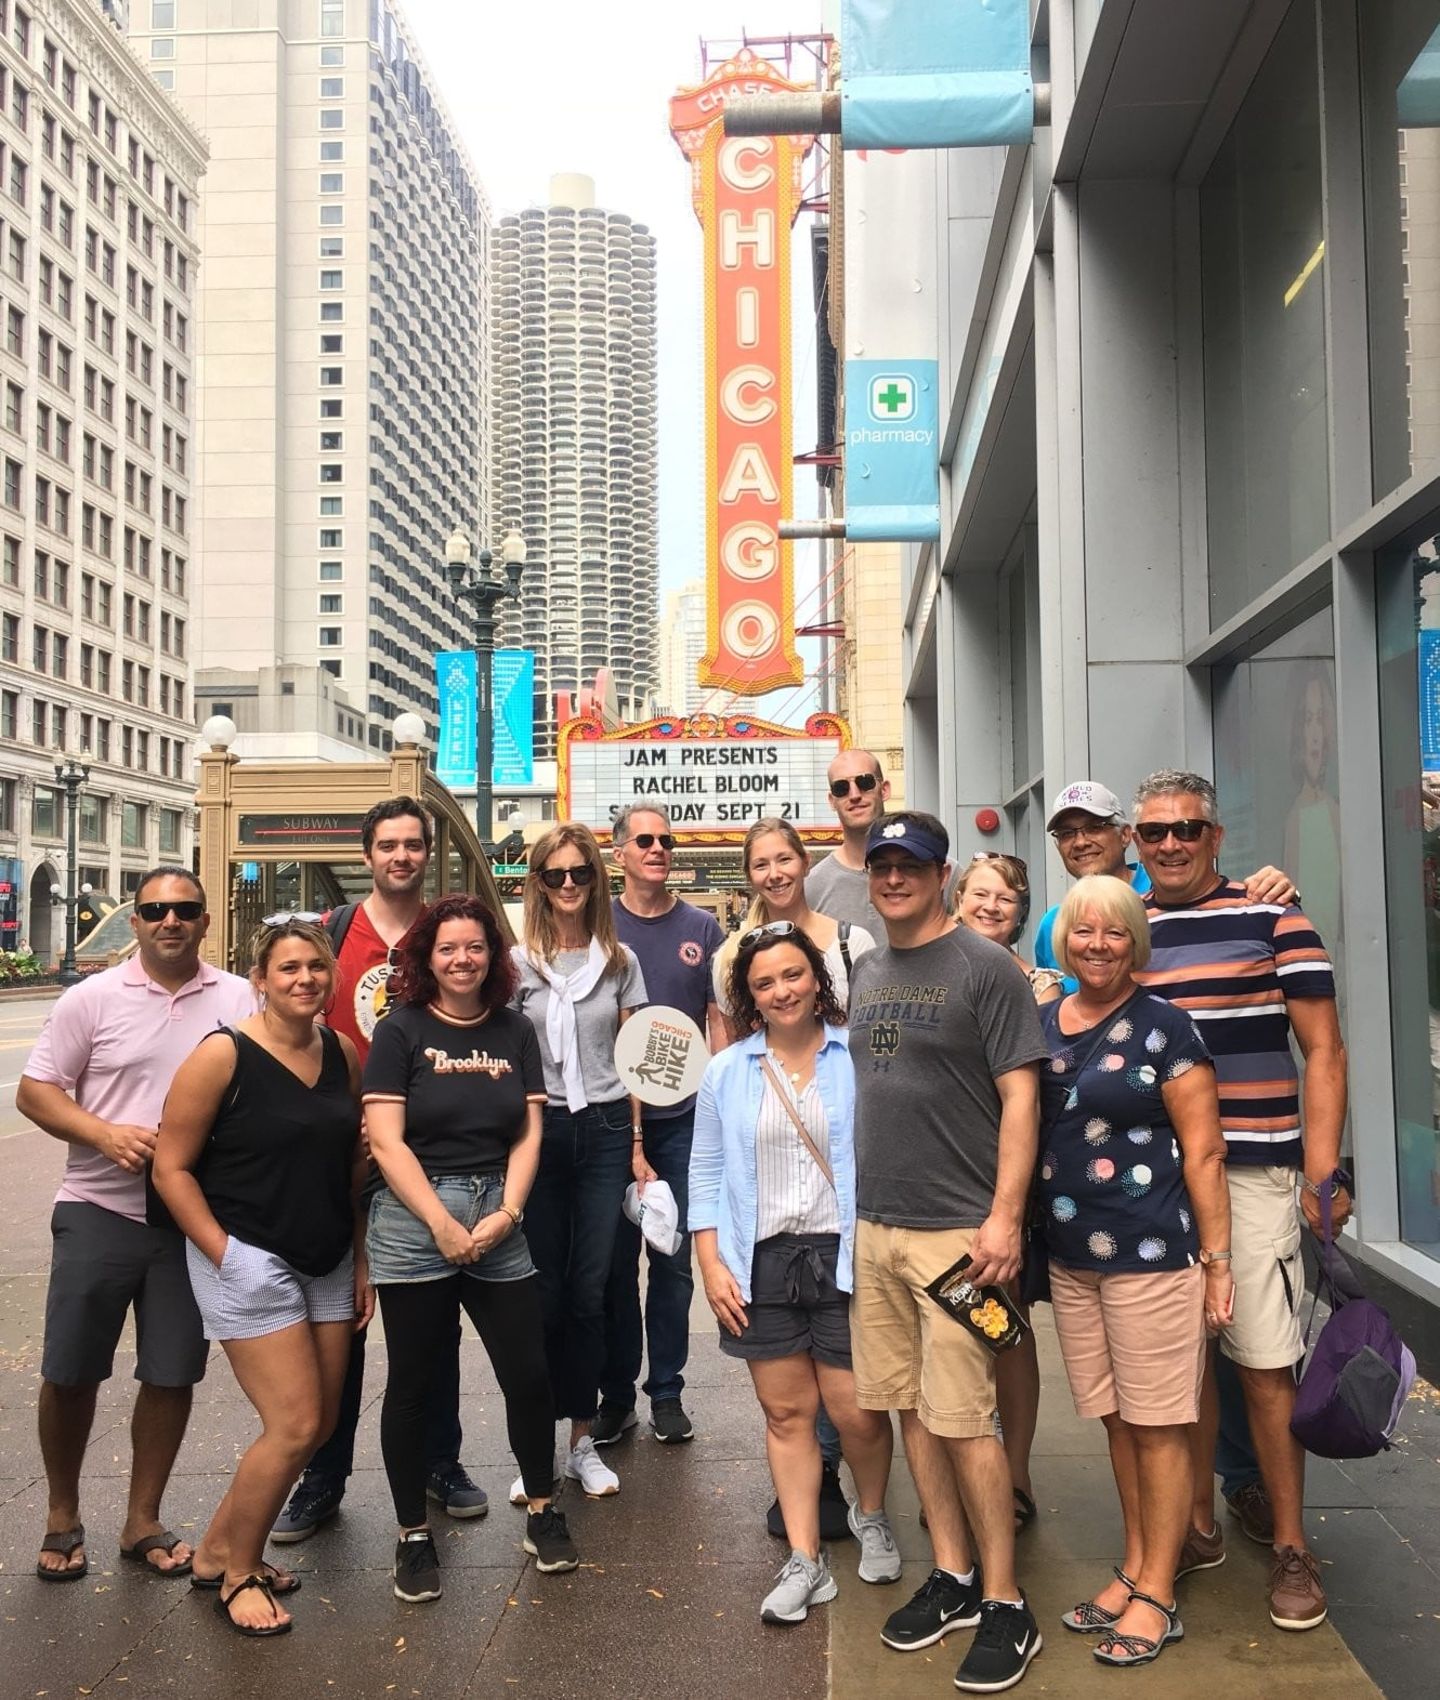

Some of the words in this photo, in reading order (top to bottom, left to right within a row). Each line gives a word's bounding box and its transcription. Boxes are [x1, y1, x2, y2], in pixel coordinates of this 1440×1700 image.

[719, 134, 781, 661] CHICAGO
[851, 428, 934, 450] pharmacy
[624, 749, 667, 766] JAM
[681, 747, 778, 765] PRESENTS
[633, 776, 708, 794] RACHEL
[715, 775, 779, 793] BLOOM
[609, 804, 706, 822] SDAY
[717, 803, 766, 820] SEPT
[781, 802, 800, 820] 21
[283, 817, 340, 830] SUBWAY
[505, 866, 528, 874] Bento
[361, 968, 389, 991] TUS
[860, 986, 898, 1005] NOTRE
[900, 985, 948, 1004] DAME
[651, 1021, 692, 1039] CHICAGO
[655, 1032, 671, 1066] BIKE
[424, 1047, 512, 1079] Brooklyn
[663, 1036, 690, 1091] HIKE
